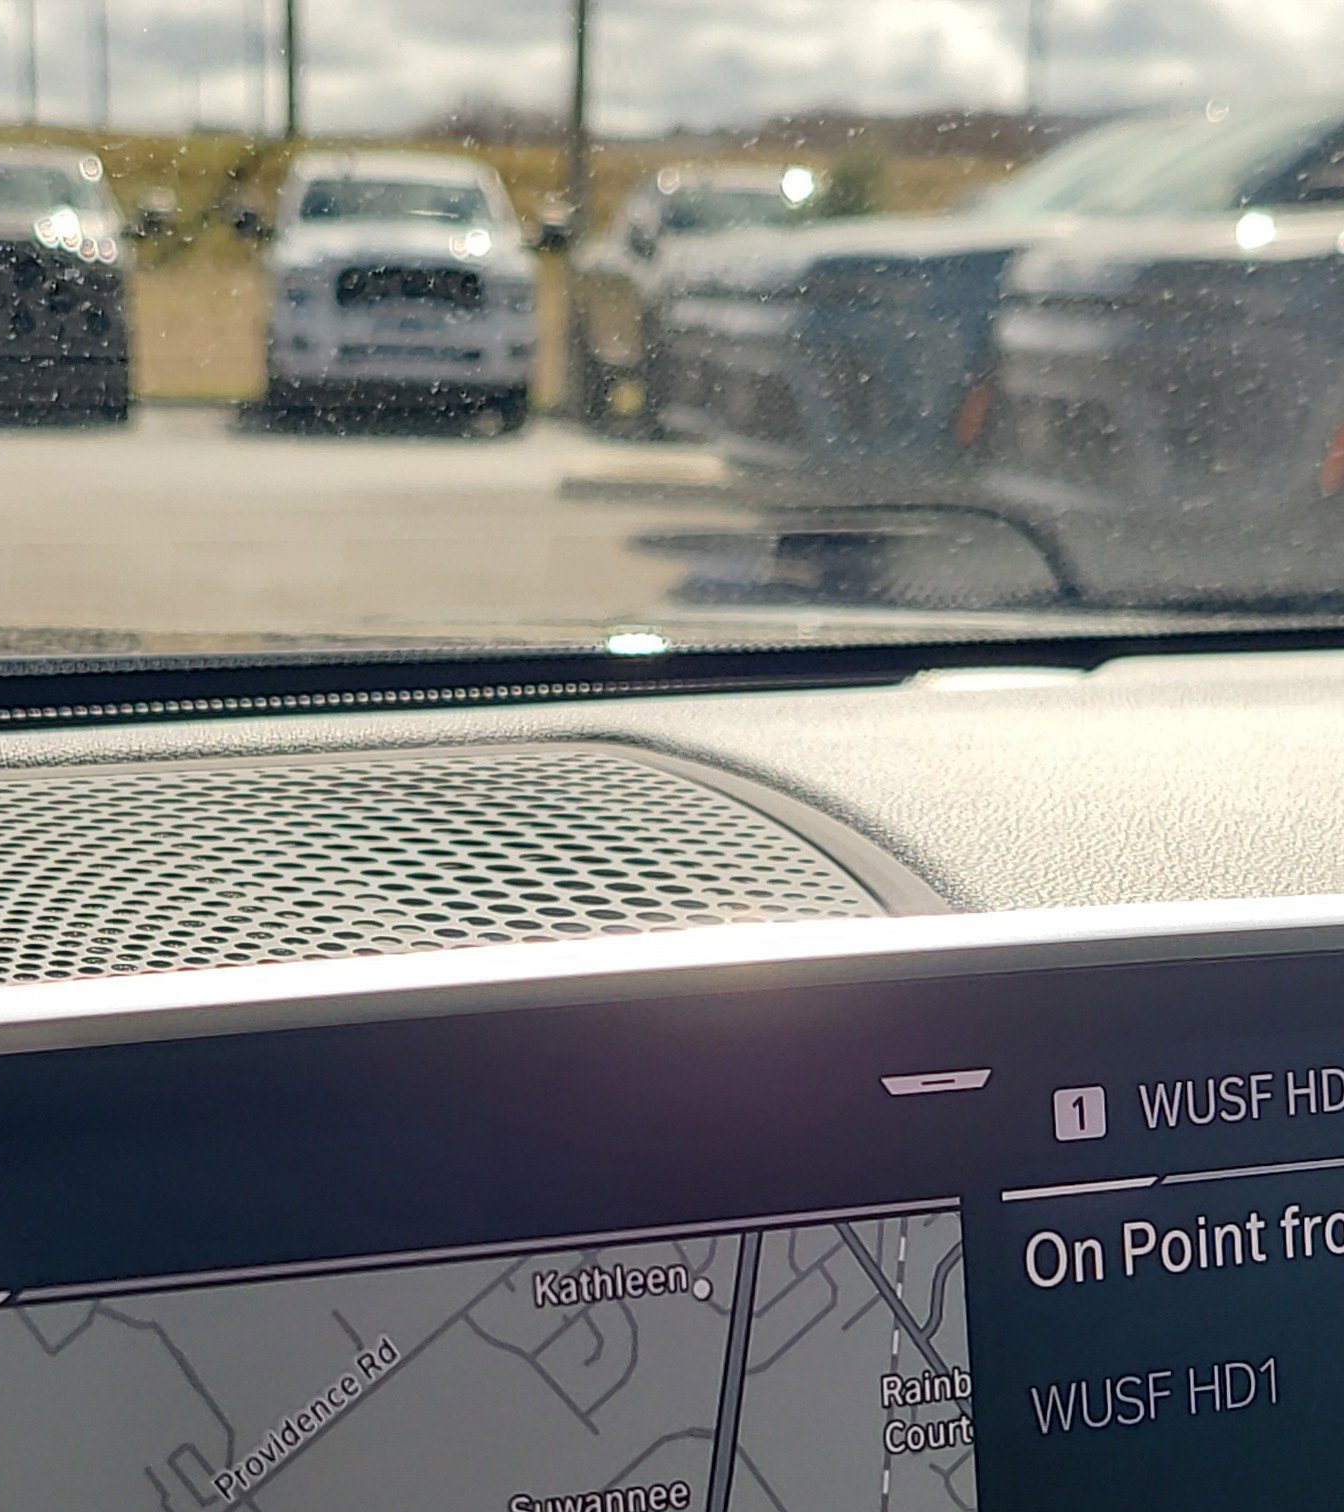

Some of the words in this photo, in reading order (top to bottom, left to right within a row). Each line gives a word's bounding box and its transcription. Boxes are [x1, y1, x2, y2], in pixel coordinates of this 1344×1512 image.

[1138, 1072, 1274, 1131] WUSF
[1024, 1229, 1106, 1288] On
[1122, 1209, 1268, 1276] Point
[534, 1263, 690, 1305] Kathleen
[881, 1368, 972, 1408] Rainb
[1030, 1370, 1172, 1434] WUSF
[1187, 1357, 1281, 1415] HD1
[214, 1374, 360, 1501] Providence
[356, 1336, 400, 1381] Rd
[884, 1414, 973, 1454] Court
